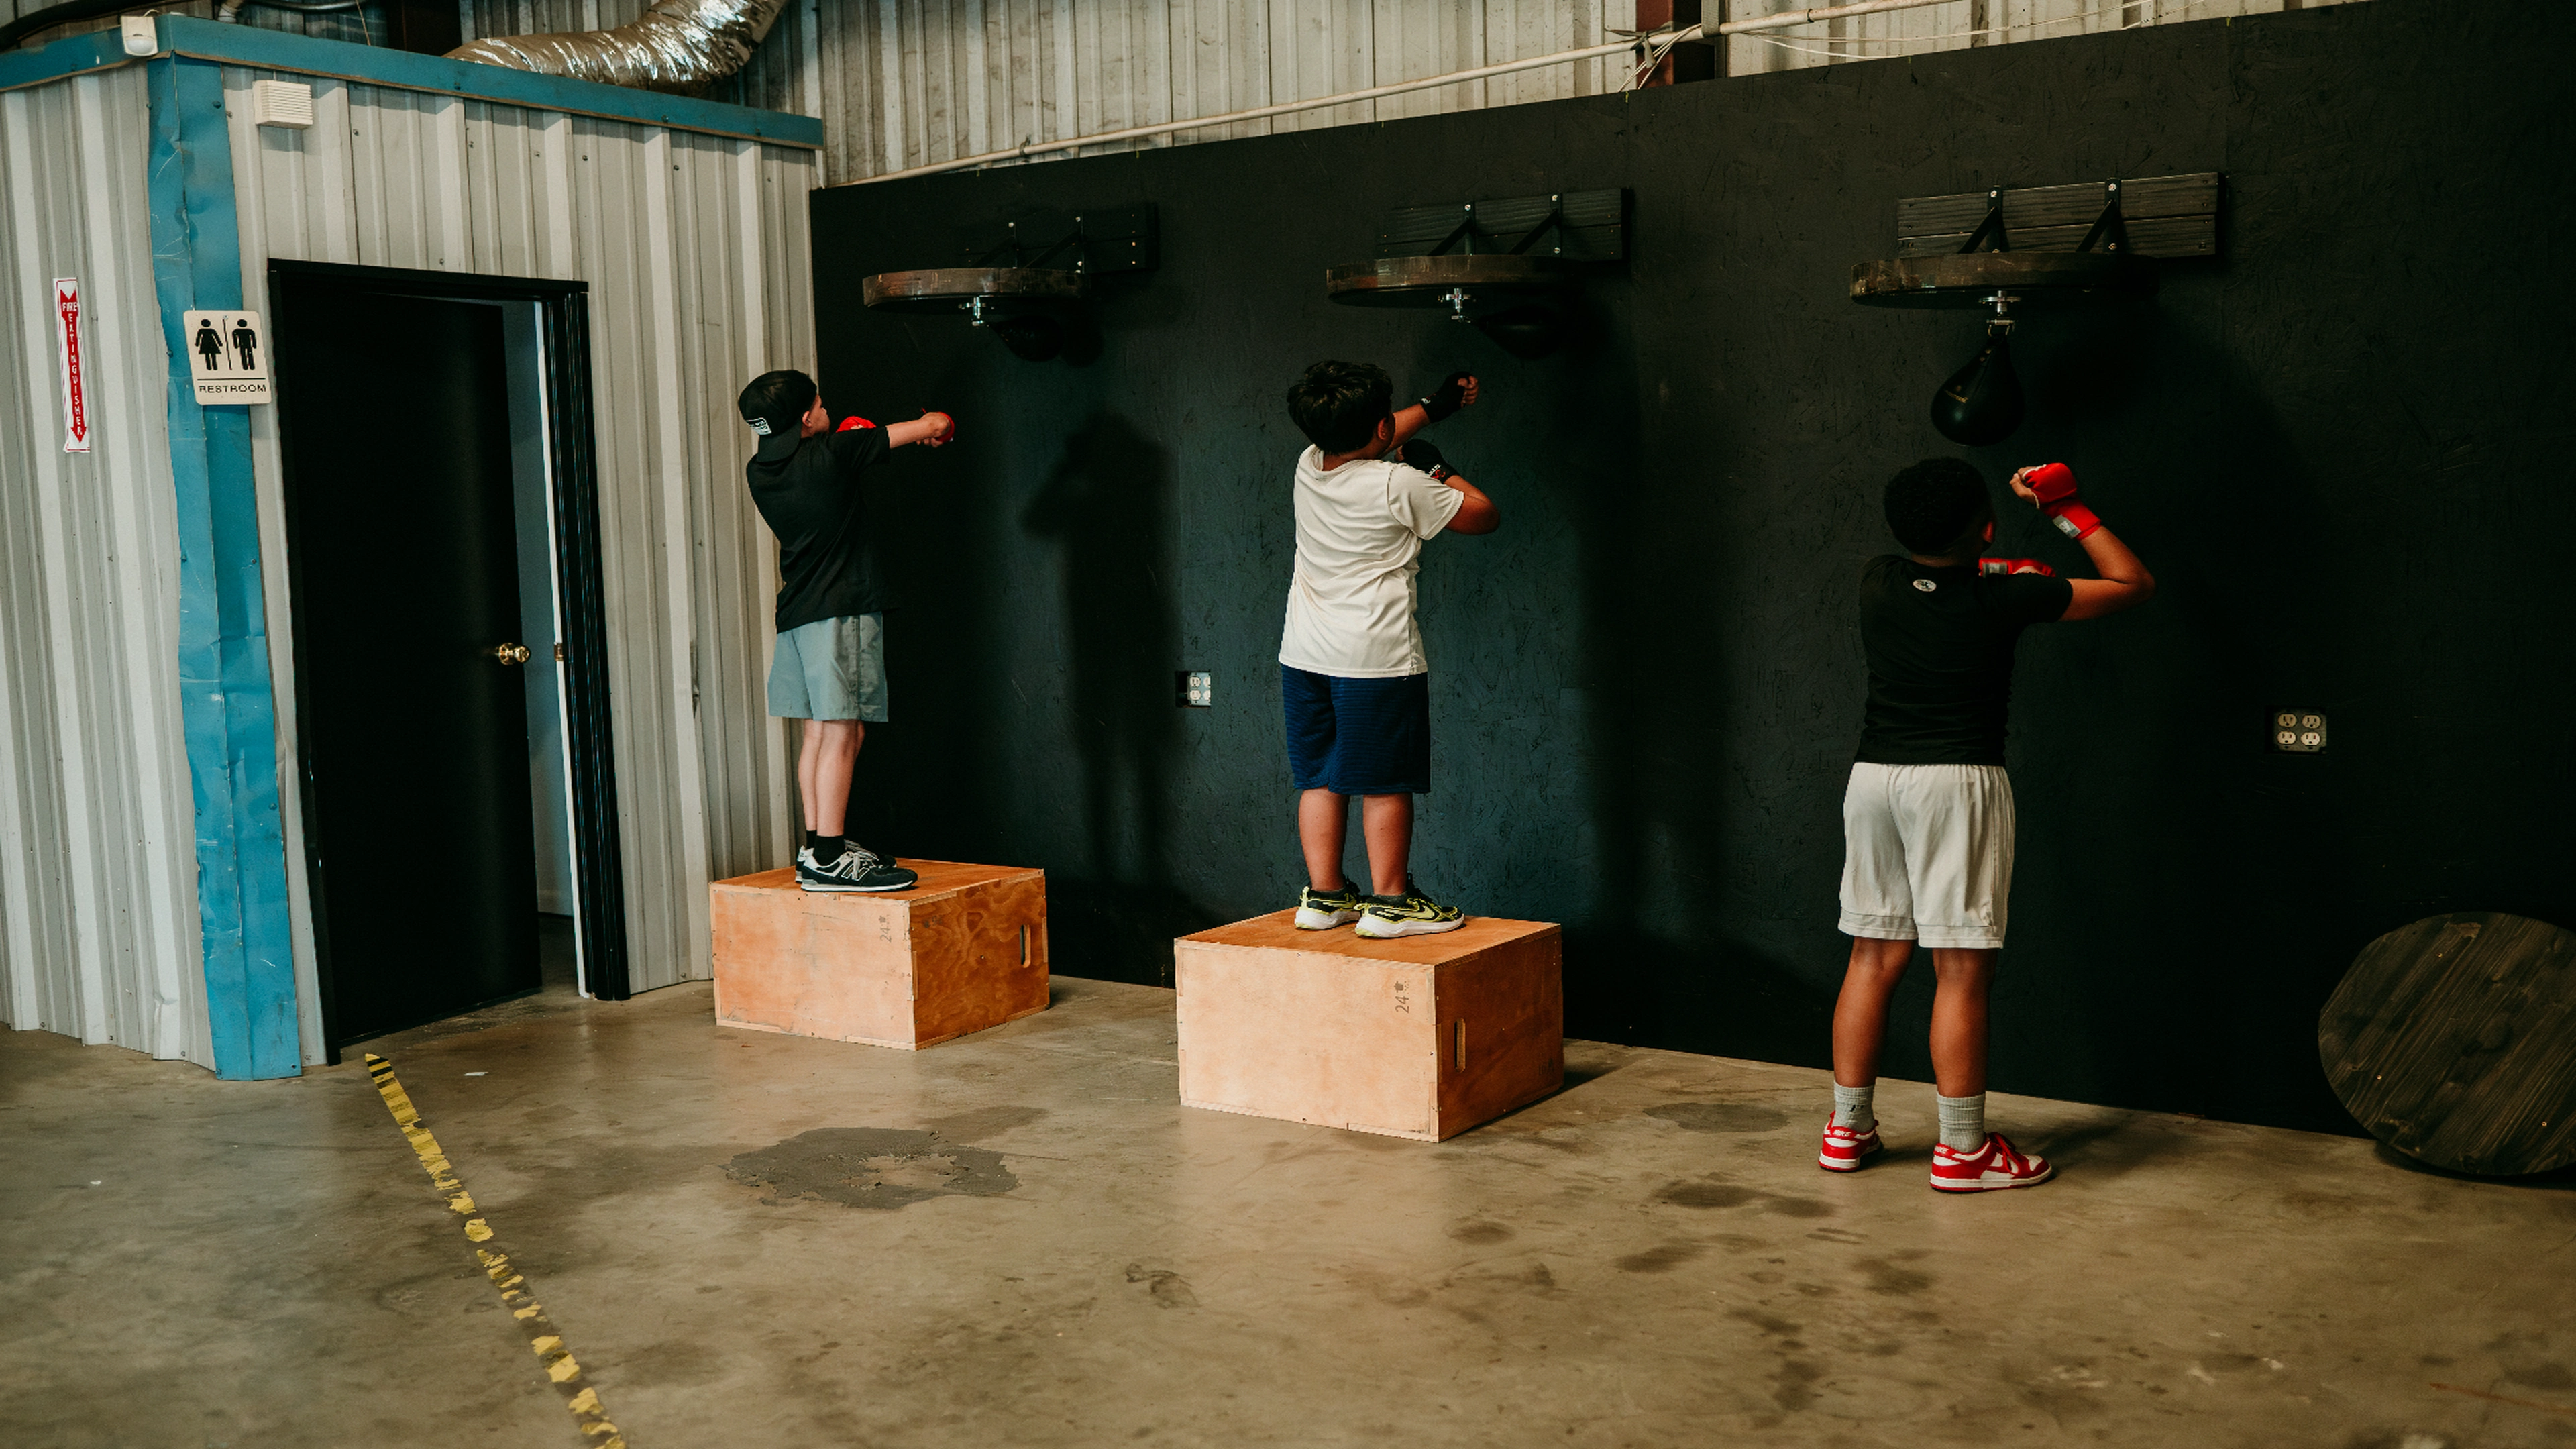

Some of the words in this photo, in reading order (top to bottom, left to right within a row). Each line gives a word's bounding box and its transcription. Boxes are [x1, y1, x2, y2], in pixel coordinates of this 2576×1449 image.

[62, 302, 78, 312] FIRE
[68, 313, 83, 435] EXTINGUISHER
[199, 384, 266, 393] RESTROOM
[879, 926, 892, 943] 24
[1395, 996, 1409, 1014] 24
